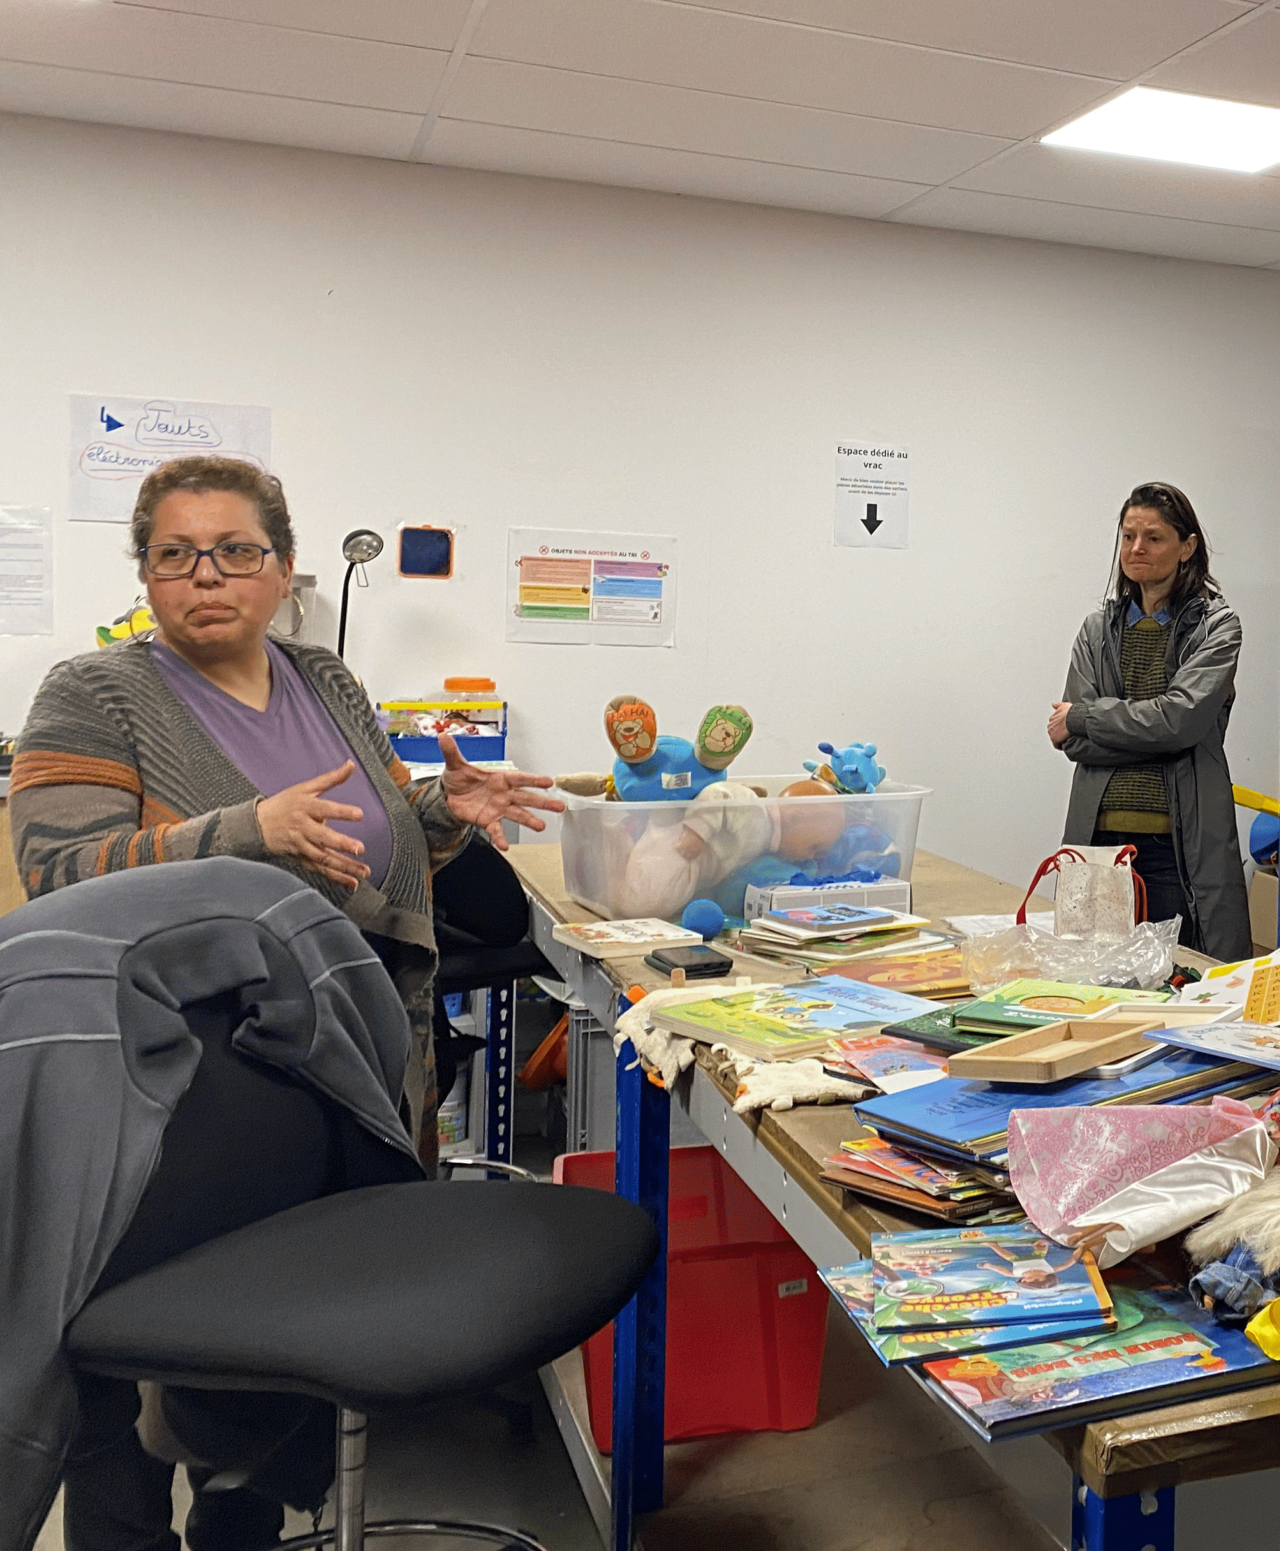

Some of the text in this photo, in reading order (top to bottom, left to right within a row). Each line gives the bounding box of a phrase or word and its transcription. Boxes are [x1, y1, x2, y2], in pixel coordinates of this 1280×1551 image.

[837, 446, 868, 456] Espace
[870, 448, 894, 458] dédié
[863, 462, 883, 470] vrac
[904, 1291, 1001, 1305] Trouve
[1022, 1298, 1084, 1310] playmobil
[898, 1299, 1007, 1313] Cherche
[1010, 1332, 1200, 1378] ROBIN DES BOIS
